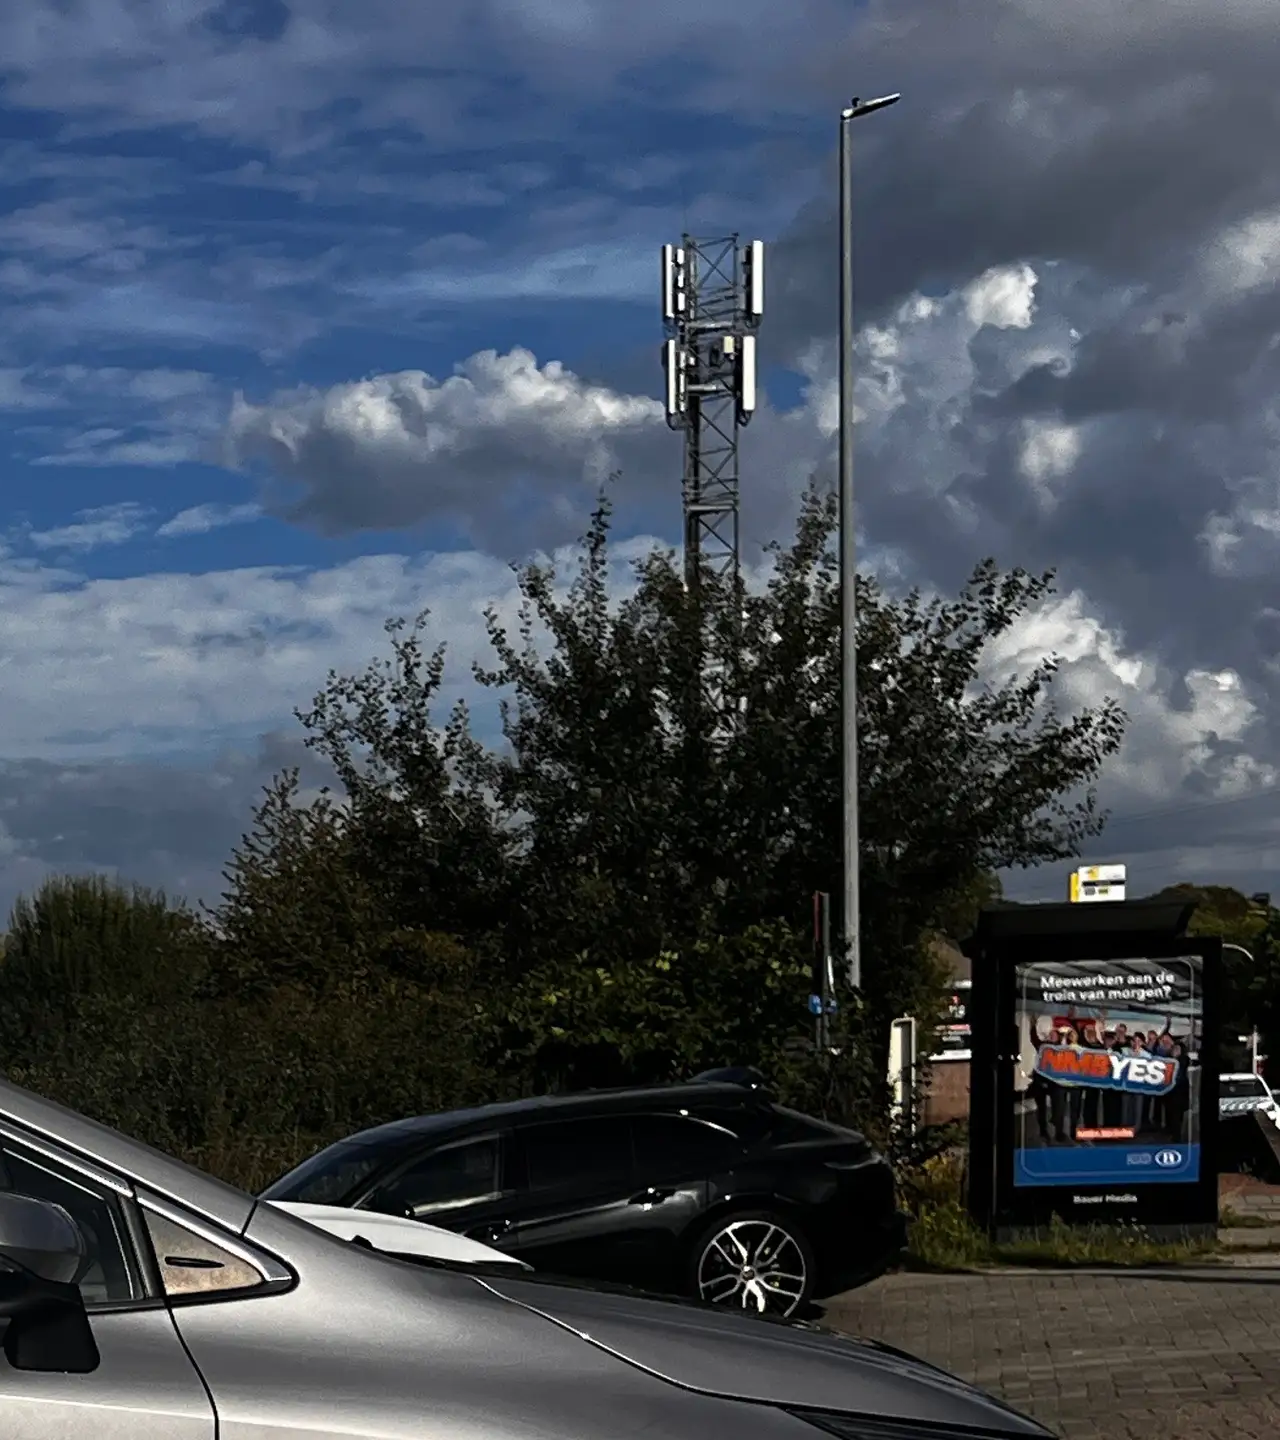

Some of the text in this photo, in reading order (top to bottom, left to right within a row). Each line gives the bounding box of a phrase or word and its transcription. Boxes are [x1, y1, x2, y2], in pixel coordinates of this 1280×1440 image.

[1040, 971, 1175, 988] Meewerken aan de
[1043, 985, 1172, 1002] trein van morgen?
